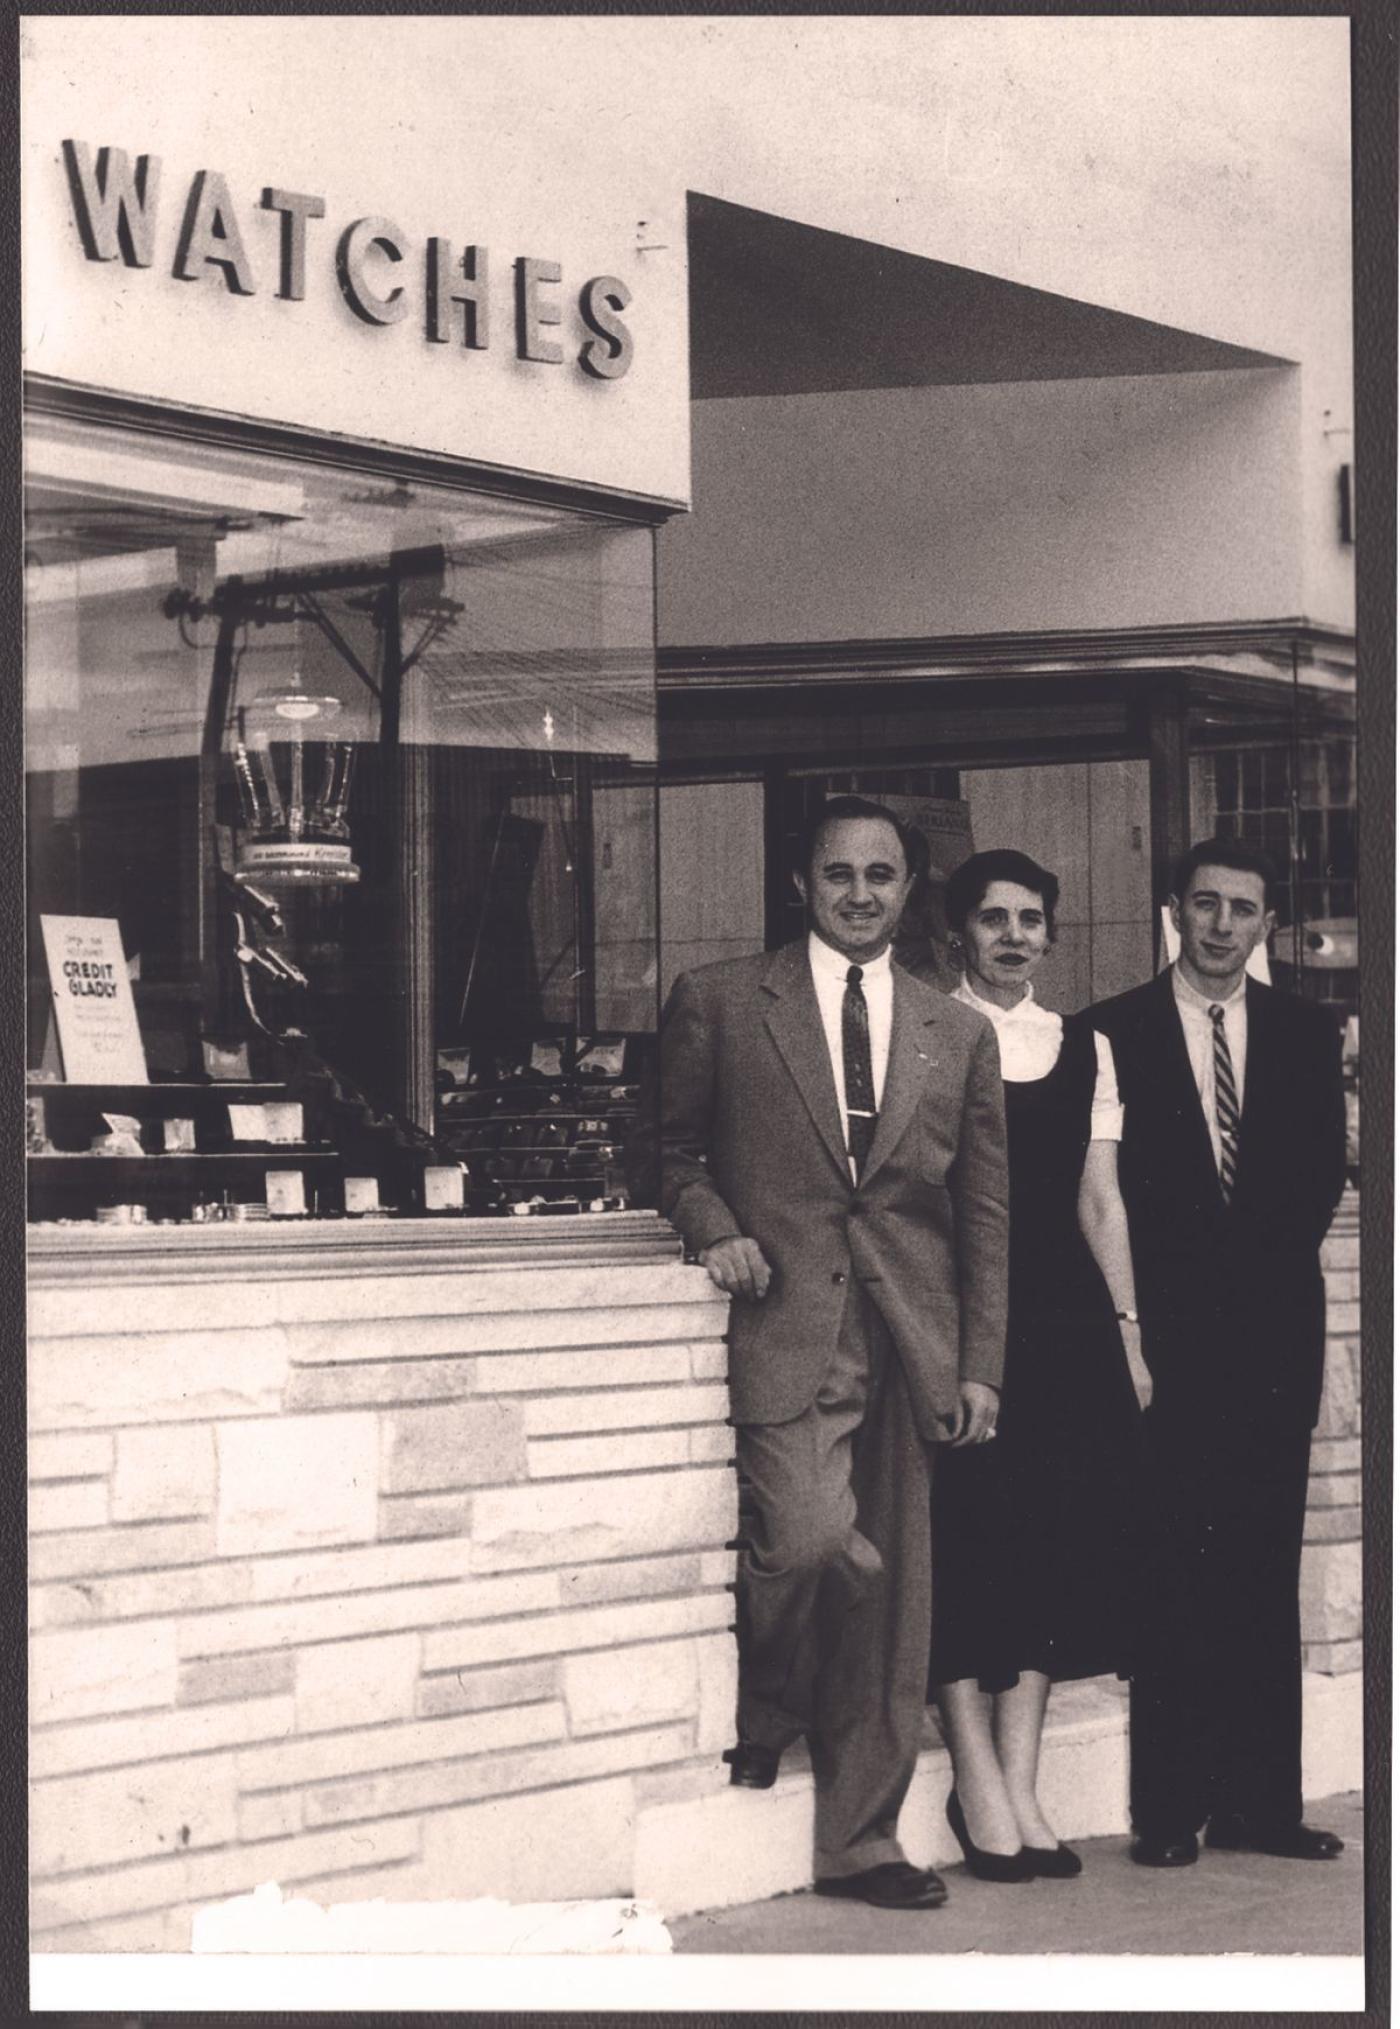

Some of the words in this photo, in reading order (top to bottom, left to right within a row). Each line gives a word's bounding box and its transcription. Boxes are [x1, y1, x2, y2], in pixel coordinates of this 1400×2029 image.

[61, 138, 635, 380] WATCHES
[63, 961, 113, 979] CREDIT
[69, 981, 117, 998] GLADLY
